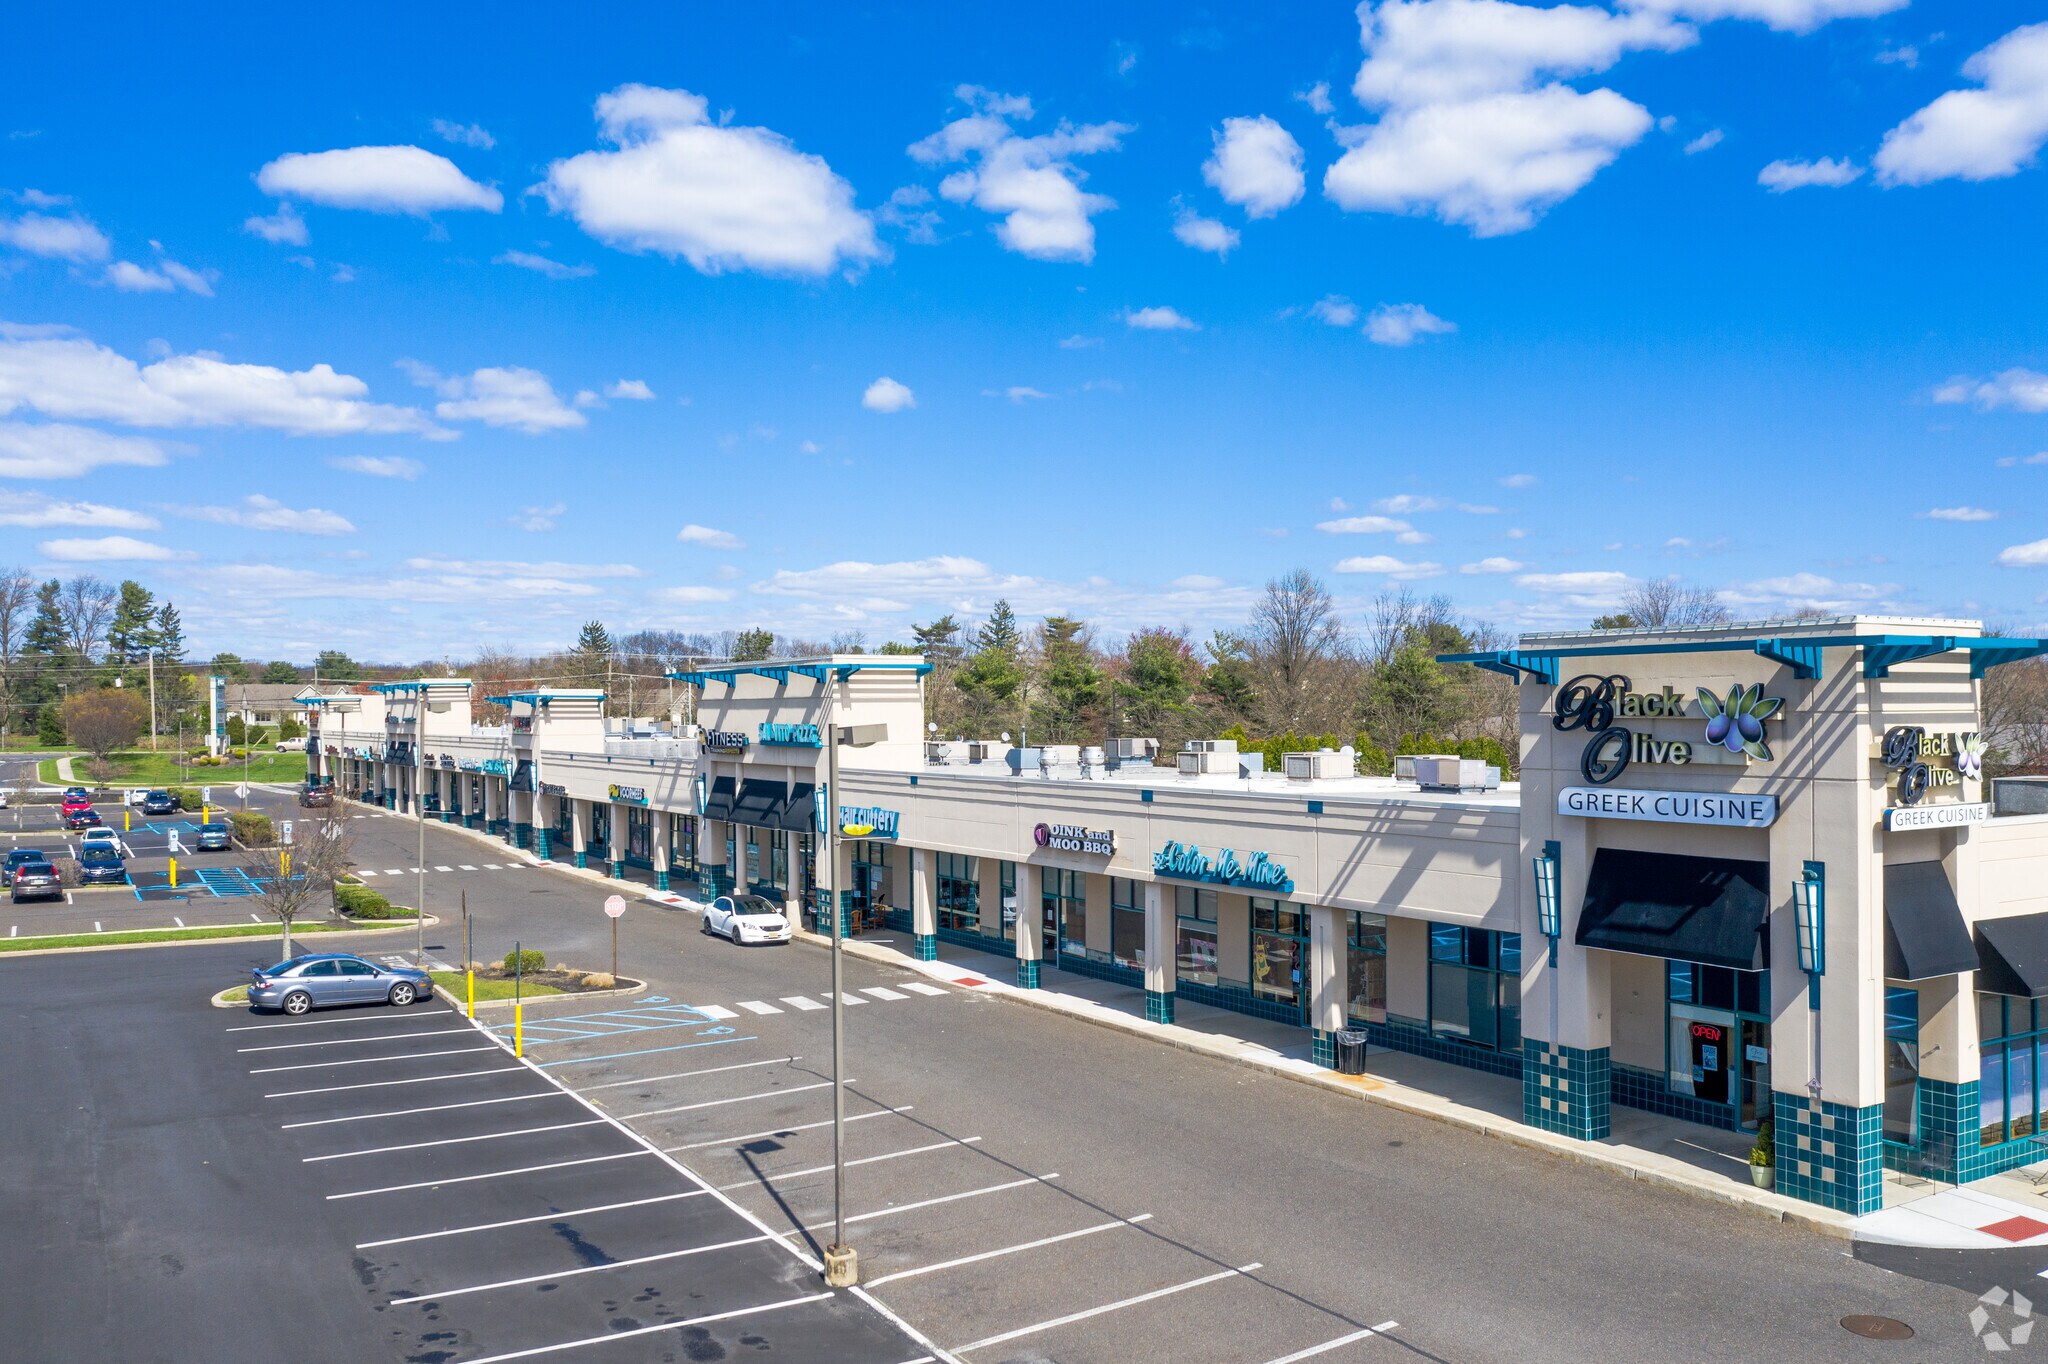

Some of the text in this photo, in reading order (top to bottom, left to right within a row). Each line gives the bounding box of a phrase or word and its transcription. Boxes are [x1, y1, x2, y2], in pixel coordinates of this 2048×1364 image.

[1553, 674, 1686, 732] Black
[707, 730, 743, 747] FITNESS
[1882, 726, 1949, 768] Black
[1581, 727, 1691, 785] Olive
[1898, 762, 1954, 804] Olive
[1568, 792, 1764, 821] GREEK CUISINE
[1895, 807, 1983, 827] GREEK CUISINE
[1049, 837, 1112, 856] MOO BBQ
[1050, 824, 1111, 841] OINK and
[1168, 843, 1286, 885] Color Me Mine
[1692, 1025, 1719, 1041] OPEN
